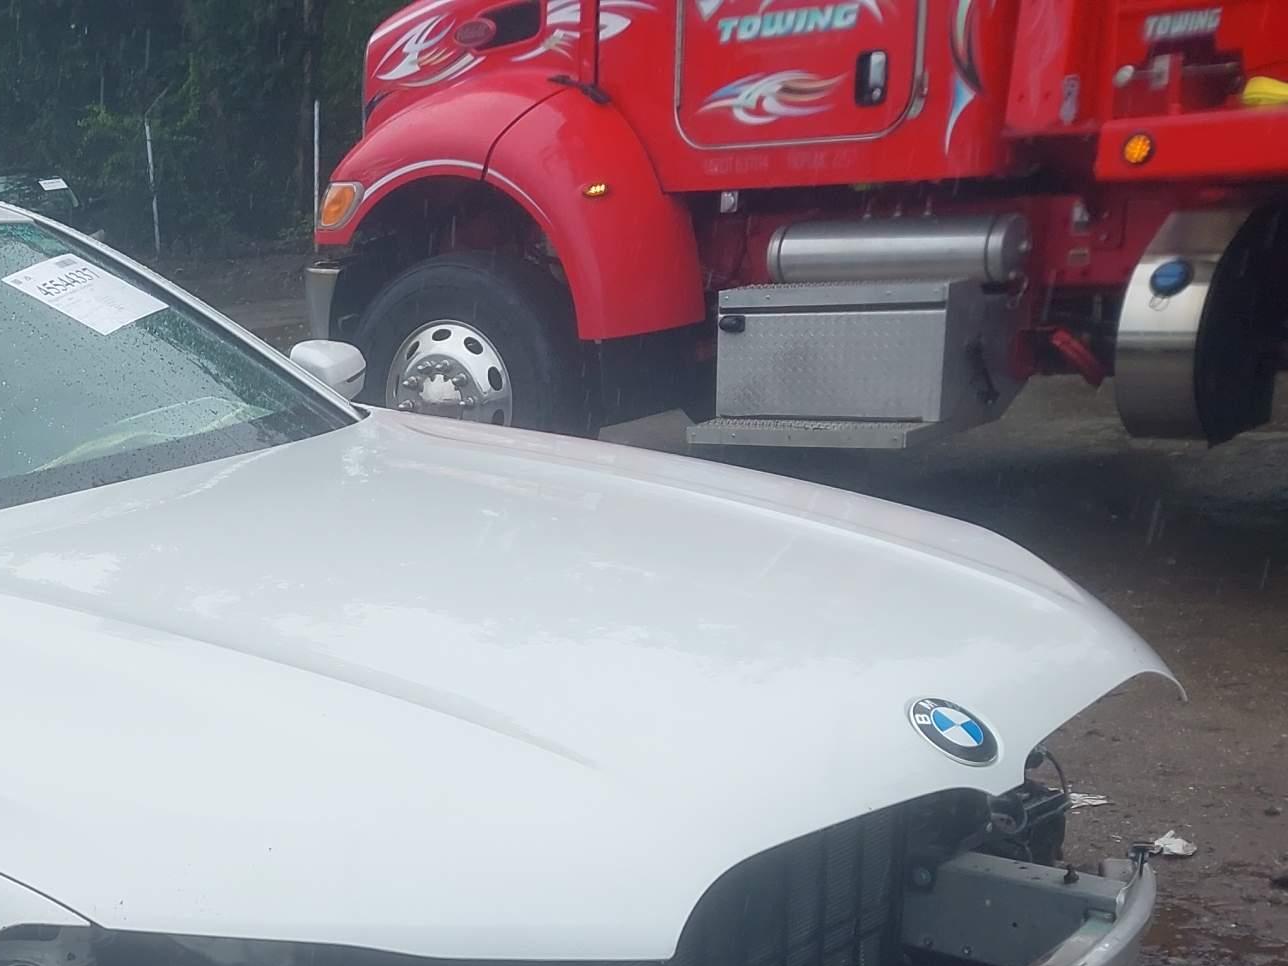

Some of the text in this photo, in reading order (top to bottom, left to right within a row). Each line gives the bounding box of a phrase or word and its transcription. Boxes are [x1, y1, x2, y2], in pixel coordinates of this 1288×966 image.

[718, 4, 859, 44] TOWING
[1143, 7, 1223, 40] TOWING
[36, 267, 100, 296] 45544337
